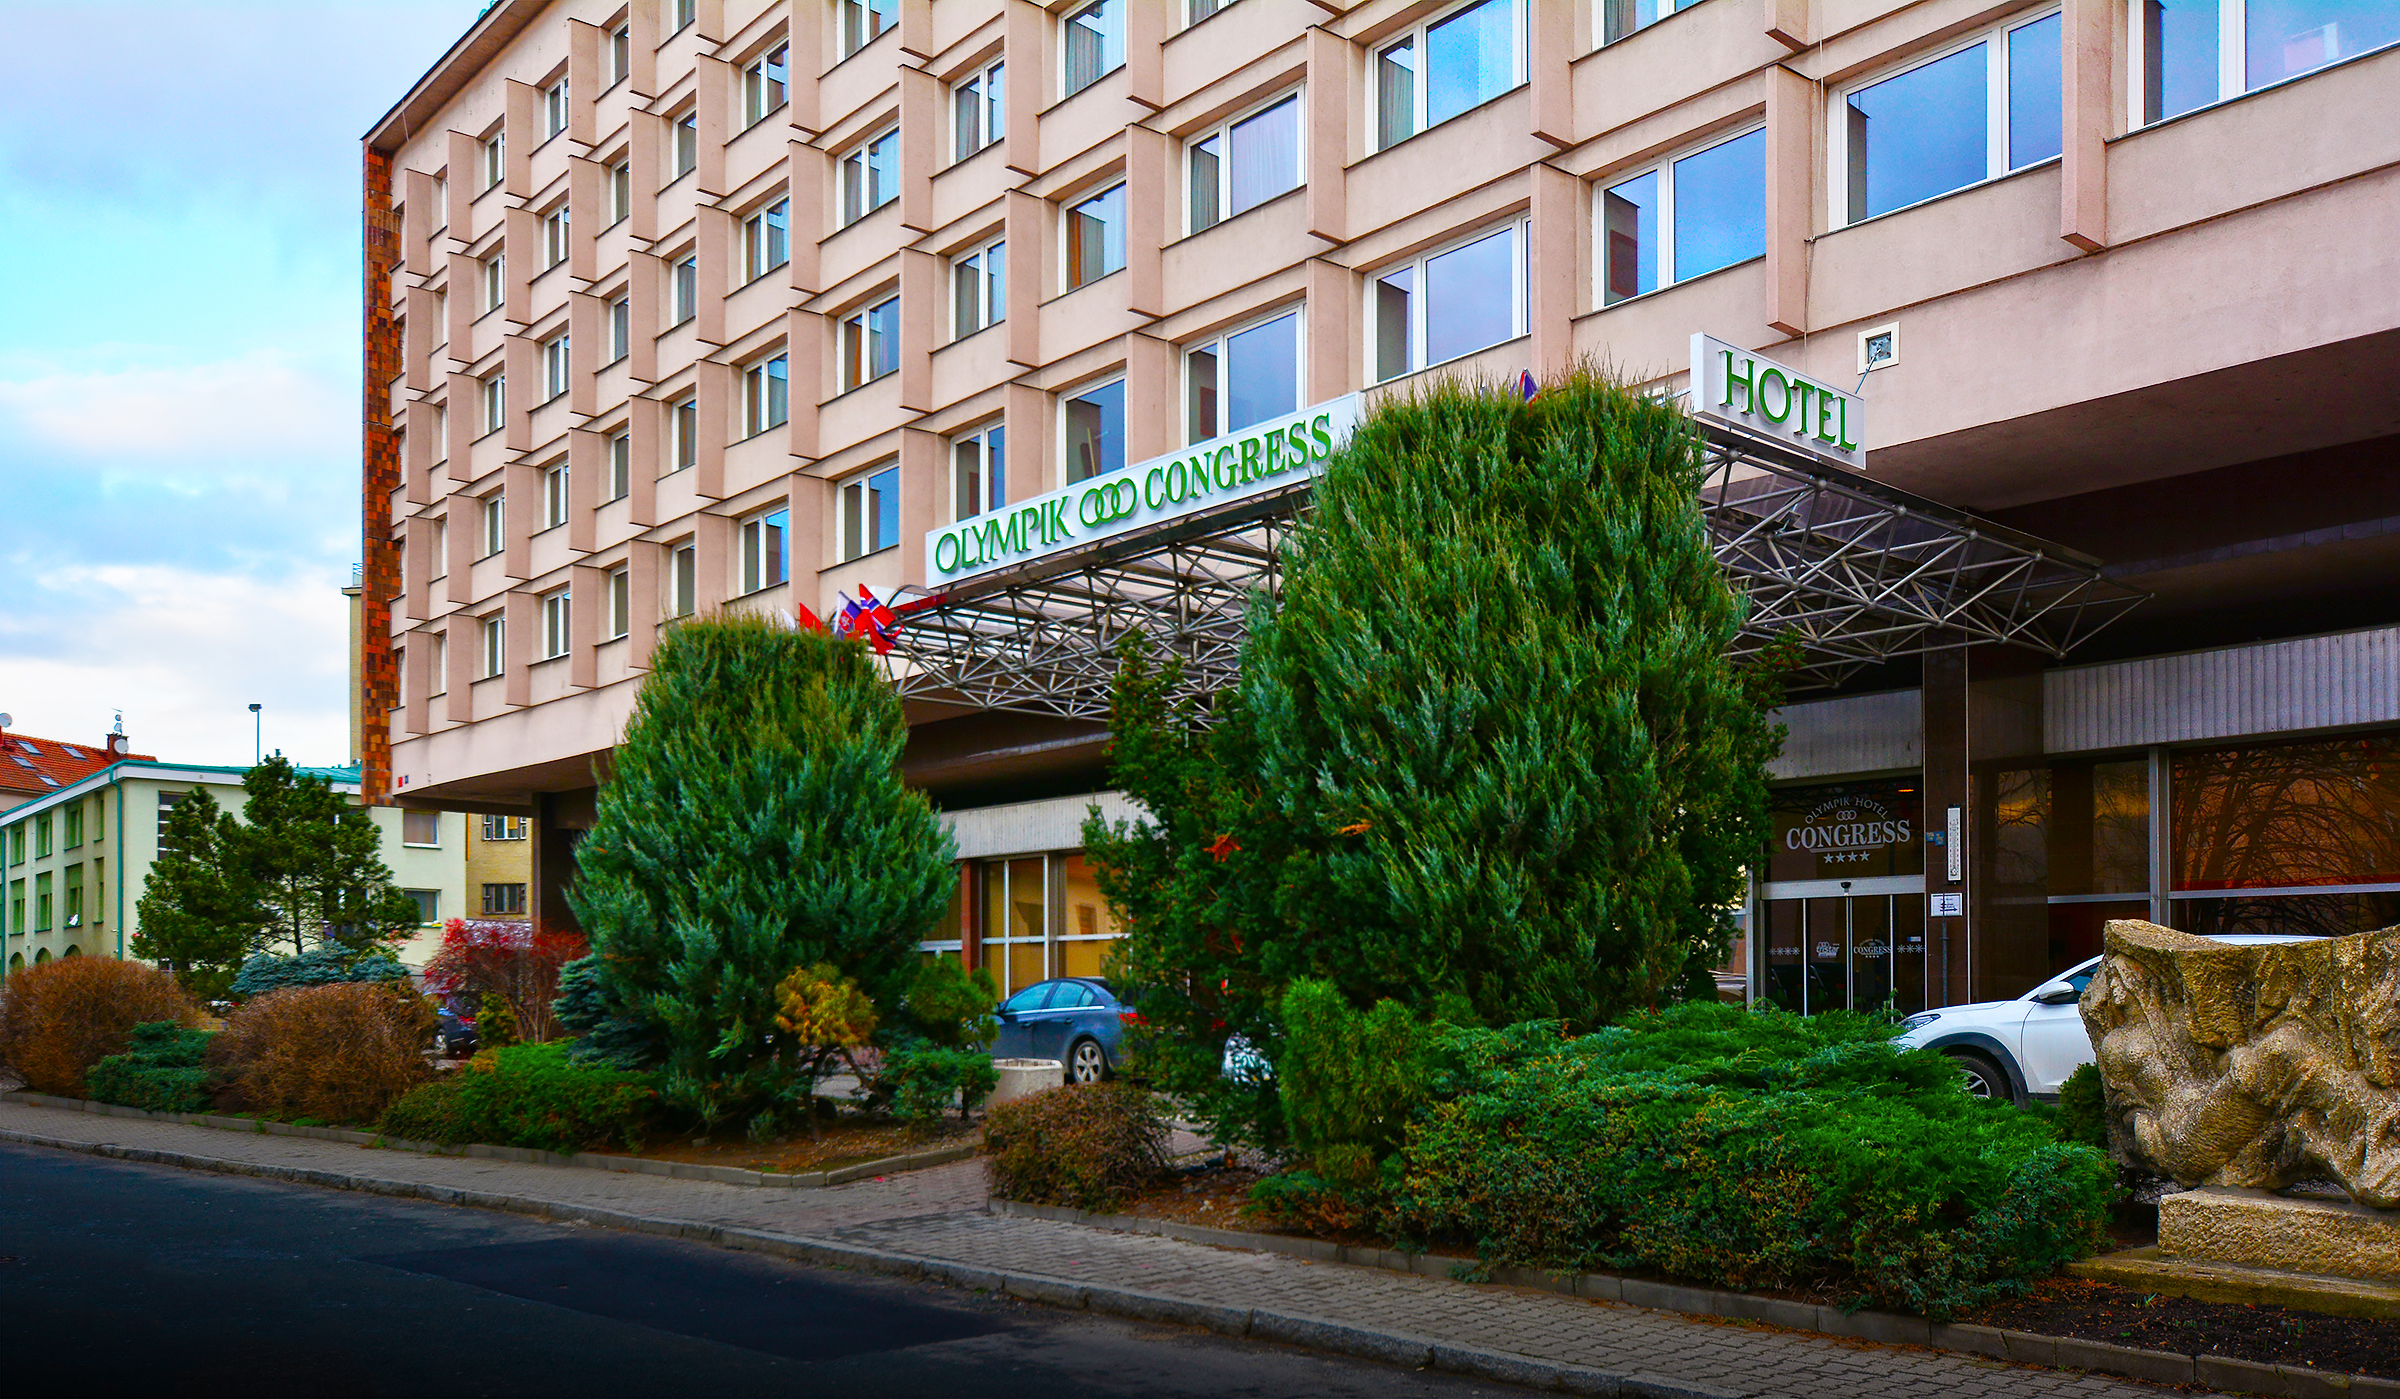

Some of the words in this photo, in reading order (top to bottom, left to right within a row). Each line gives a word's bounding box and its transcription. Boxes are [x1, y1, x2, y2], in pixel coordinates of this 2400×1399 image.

[1719, 349, 1858, 453] HOTEL
[935, 495, 1075, 574] OLYMPIK
[1145, 412, 1333, 511] CONGRESS
[1786, 819, 1911, 850] CONGRESS
[1805, 797, 1850, 824] OLYMPIK
[1855, 797, 1890, 820] HOTEL
